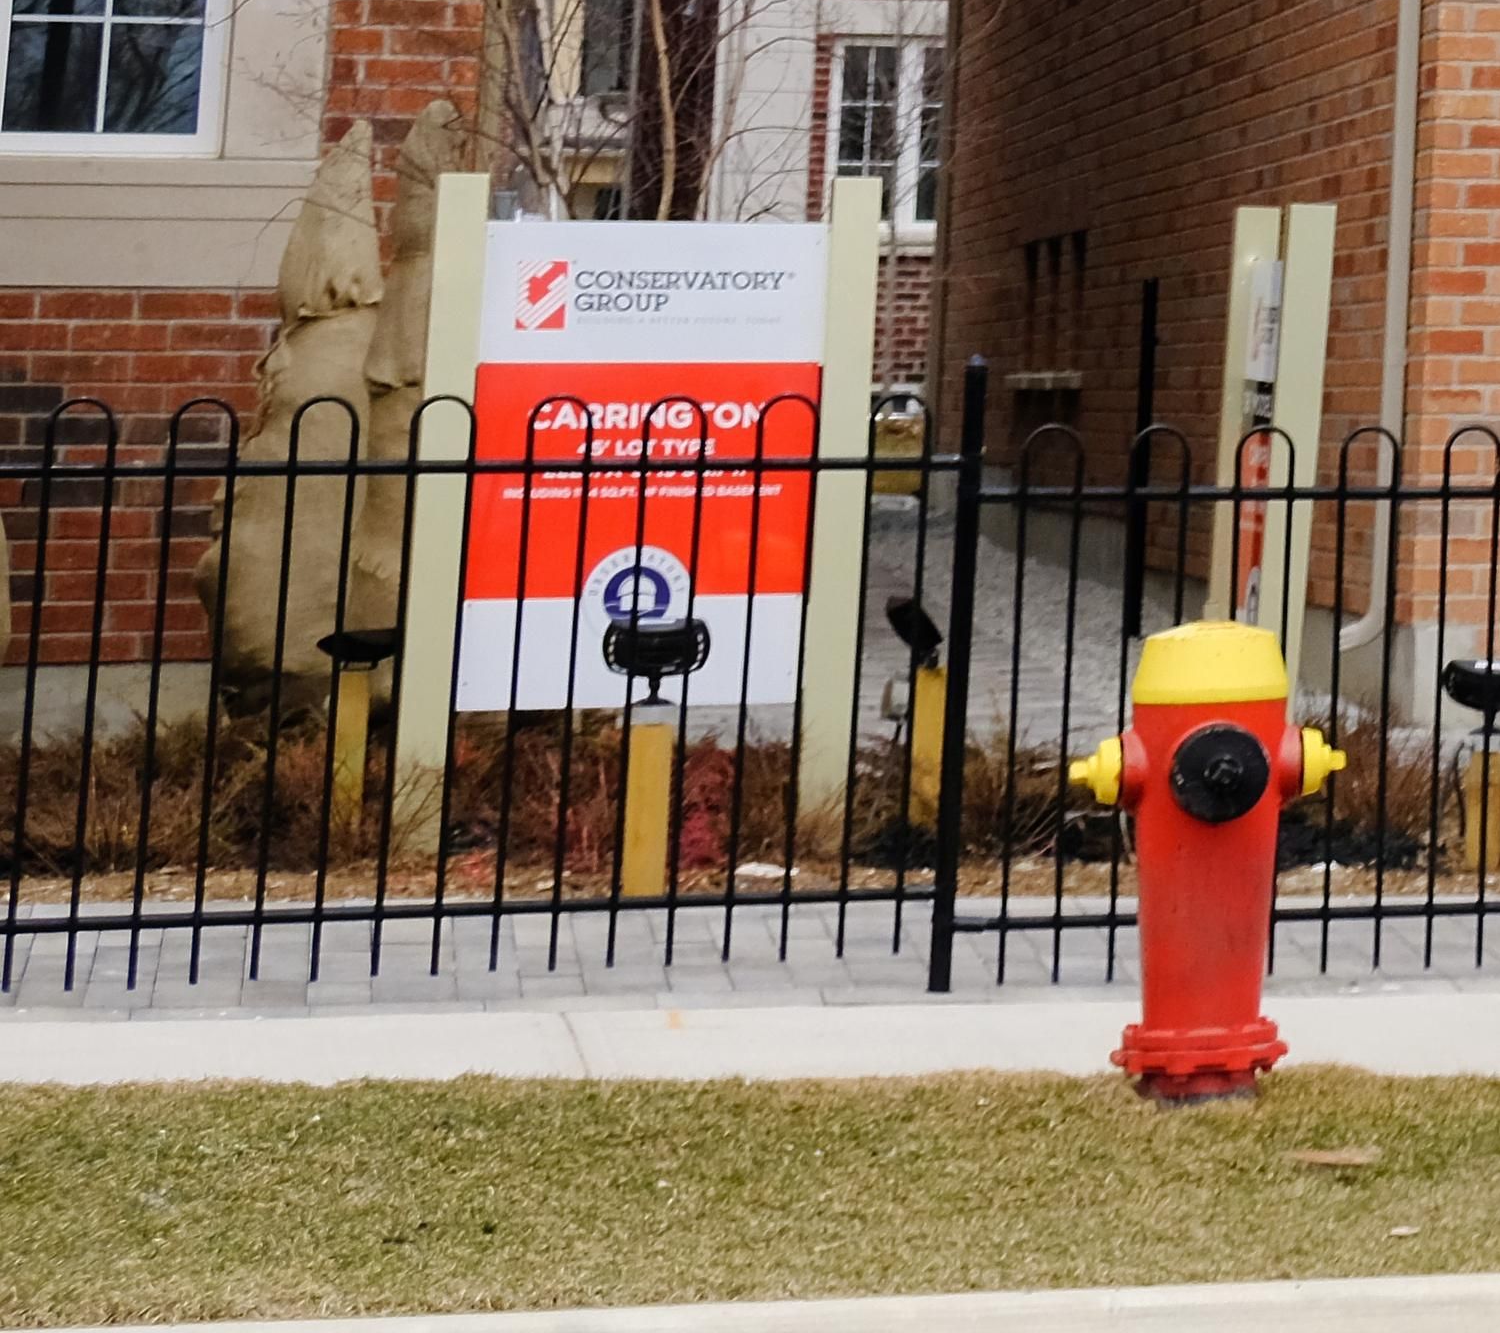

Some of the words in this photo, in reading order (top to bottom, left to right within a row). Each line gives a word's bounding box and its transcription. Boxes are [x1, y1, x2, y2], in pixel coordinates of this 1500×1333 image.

[574, 270, 786, 290] CONSERVATORY
[574, 293, 669, 312] GROUP
[615, 438, 658, 456] LOT
[661, 438, 716, 456] TYPE
